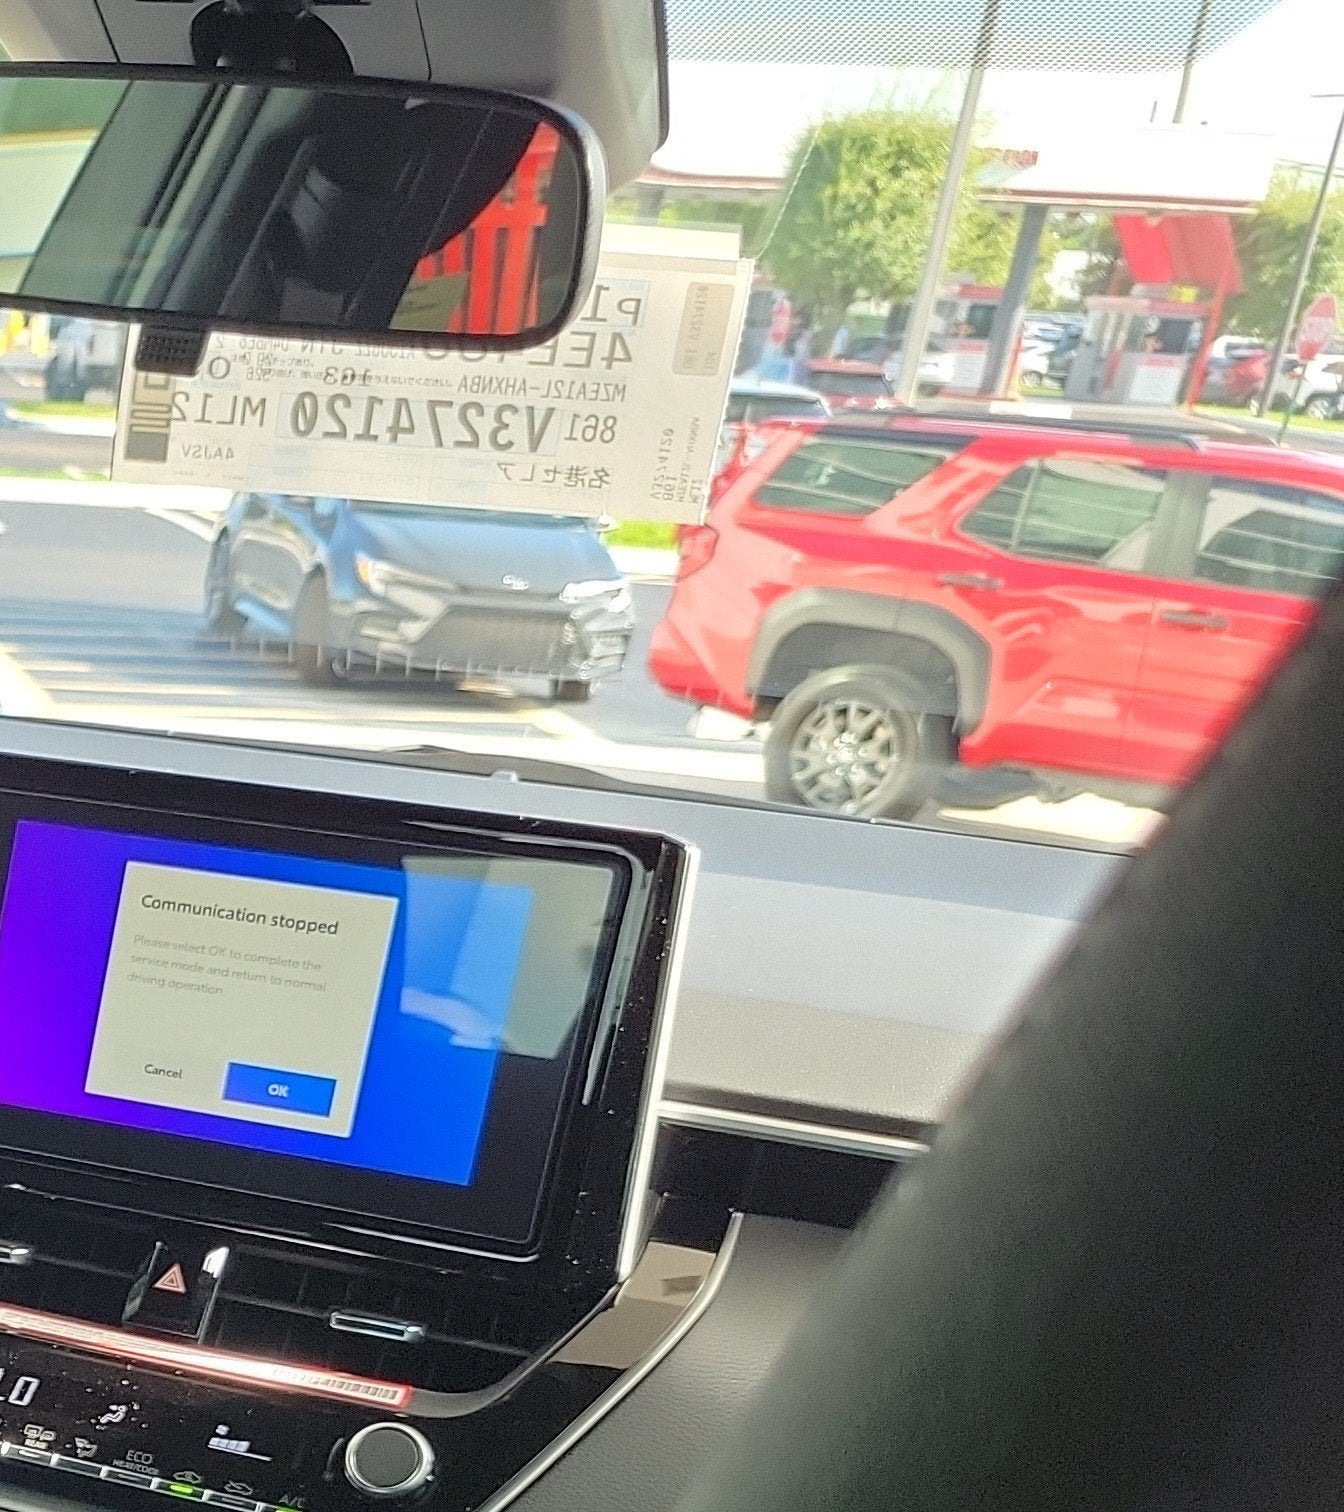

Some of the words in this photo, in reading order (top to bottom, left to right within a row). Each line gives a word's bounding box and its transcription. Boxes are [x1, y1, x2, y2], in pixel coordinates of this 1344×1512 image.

[141, 895, 267, 925] Communication
[270, 913, 339, 935] stopped
[133, 934, 170, 949] Please
[173, 940, 205, 955] select
[208, 946, 226, 957] OK
[229, 948, 242, 960] to
[243, 953, 300, 971] complete
[302, 960, 322, 972] the
[127, 971, 165, 989] driving
[168, 980, 223, 996] operation
[130, 954, 169, 968] service
[171, 960, 205, 974] mode
[206, 966, 230, 978] and
[231, 969, 267, 984] return
[270, 973, 282, 986] to
[284, 977, 328, 992] normal
[143, 1063, 183, 1080] Cancel
[267, 1083, 290, 1097] OK
[125, 1449, 154, 1465] ECO
[278, 1493, 307, 1509] A/C
